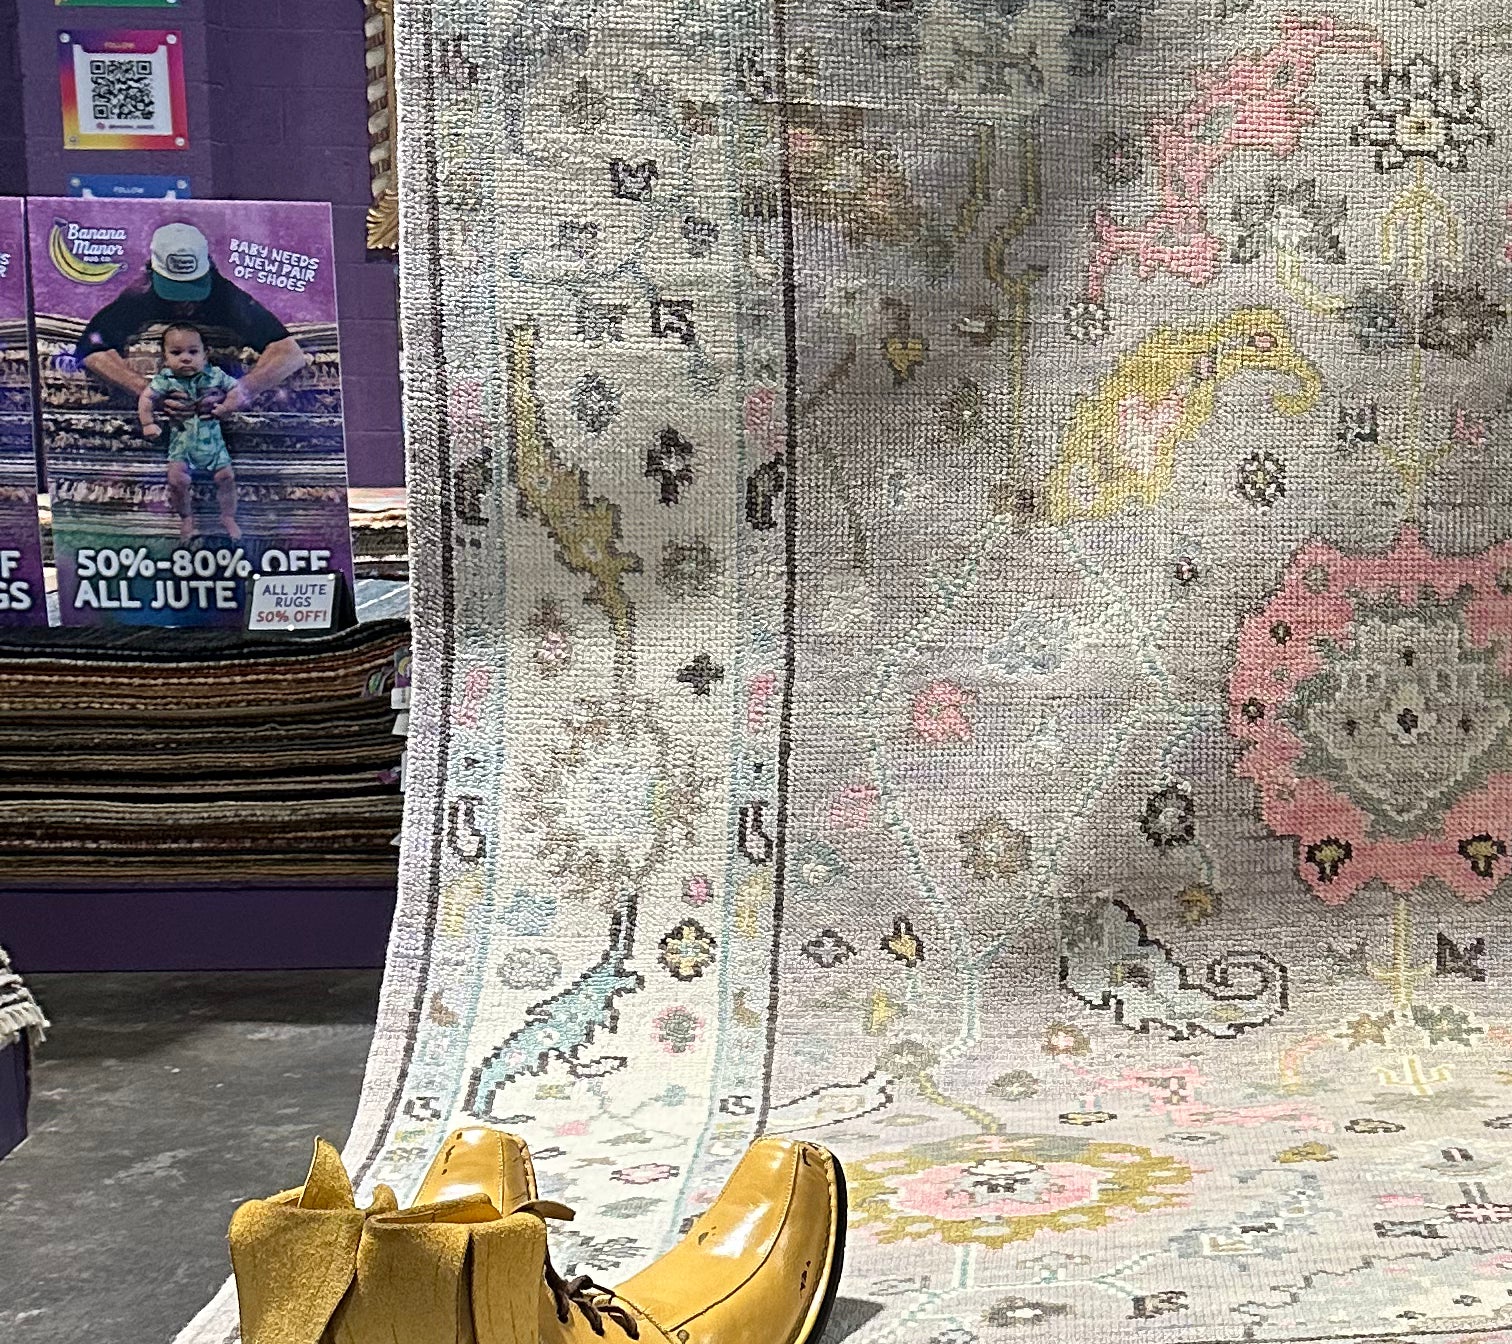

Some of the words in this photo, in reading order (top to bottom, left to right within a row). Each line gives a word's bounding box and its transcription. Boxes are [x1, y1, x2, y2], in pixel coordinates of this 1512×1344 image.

[67, 223, 127, 240] Banana
[72, 240, 125, 255] Manor
[229, 238, 268, 258] BABY
[271, 248, 320, 270] NEEDS
[228, 252, 240, 265] A
[243, 255, 279, 273] NEW
[281, 264, 315, 282] PAIR
[233, 266, 254, 279] OF
[256, 271, 307, 292] SHOES
[77, 547, 253, 578] 50%-80%
[261, 549, 331, 572] OFF
[74, 580, 142, 609] ALL
[151, 580, 238, 609] JUTE
[262, 584, 289, 596] ALL
[292, 583, 328, 595] JUTE
[275, 596, 312, 608] RUGS
[256, 610, 290, 623] 50%
[294, 610, 327, 623] OFF!
